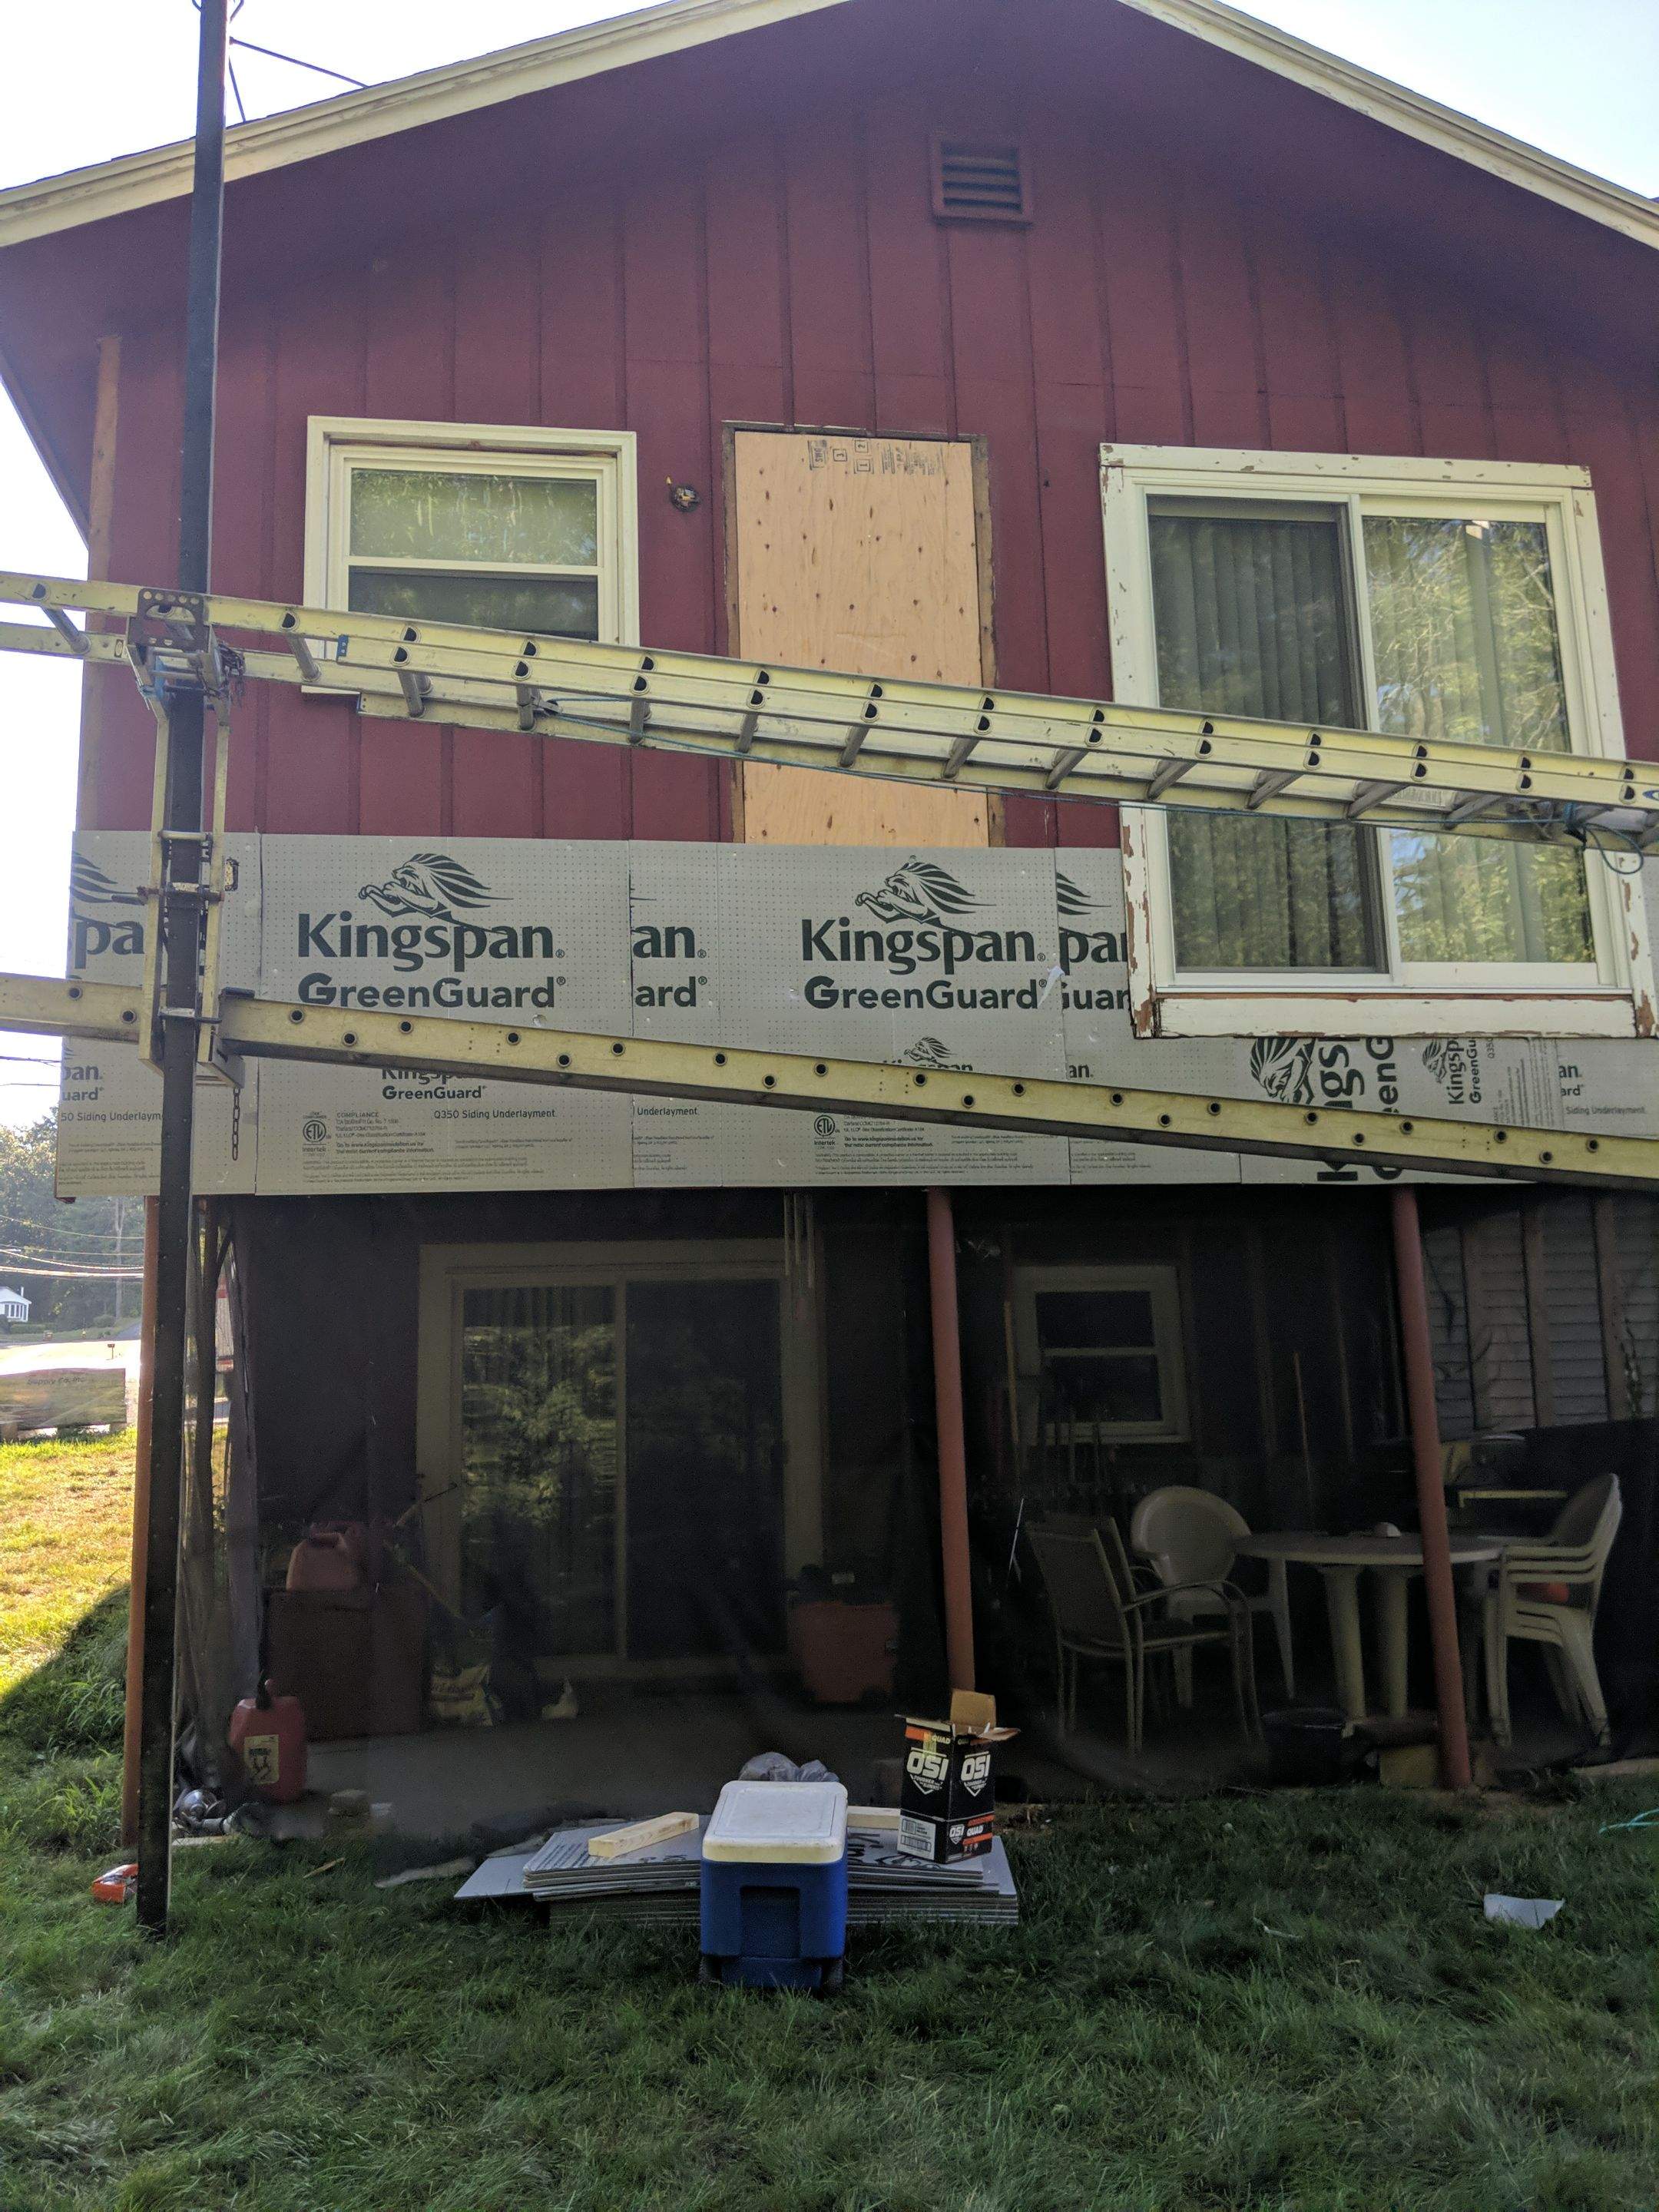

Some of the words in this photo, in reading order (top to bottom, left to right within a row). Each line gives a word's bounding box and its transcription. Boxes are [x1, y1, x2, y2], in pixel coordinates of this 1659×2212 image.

[75, 920, 144, 969] pa
[298, 910, 554, 972] Kingspan
[802, 917, 1035, 975] Kingspan
[298, 972, 555, 1008] GreenGuard
[804, 975, 1038, 1010] GreenGuard
[382, 1085, 482, 1100] GreenGuard
[77, 1113, 106, 1123] Siding
[110, 1111, 164, 1124] Underlaym
[434, 1110, 460, 1119] Q350
[462, 1110, 490, 1120] Siding
[492, 1109, 556, 1119] Underlayment
[637, 1107, 698, 1118] Underlayment
[1591, 1105, 1646, 1116] Underlayment
[932, 1734, 952, 1745] QUAD
[907, 1751, 949, 1782] OSI
[960, 1753, 991, 1783] OSI
[949, 1823, 965, 1838] OSI
[966, 1824, 984, 1837] QUAD
